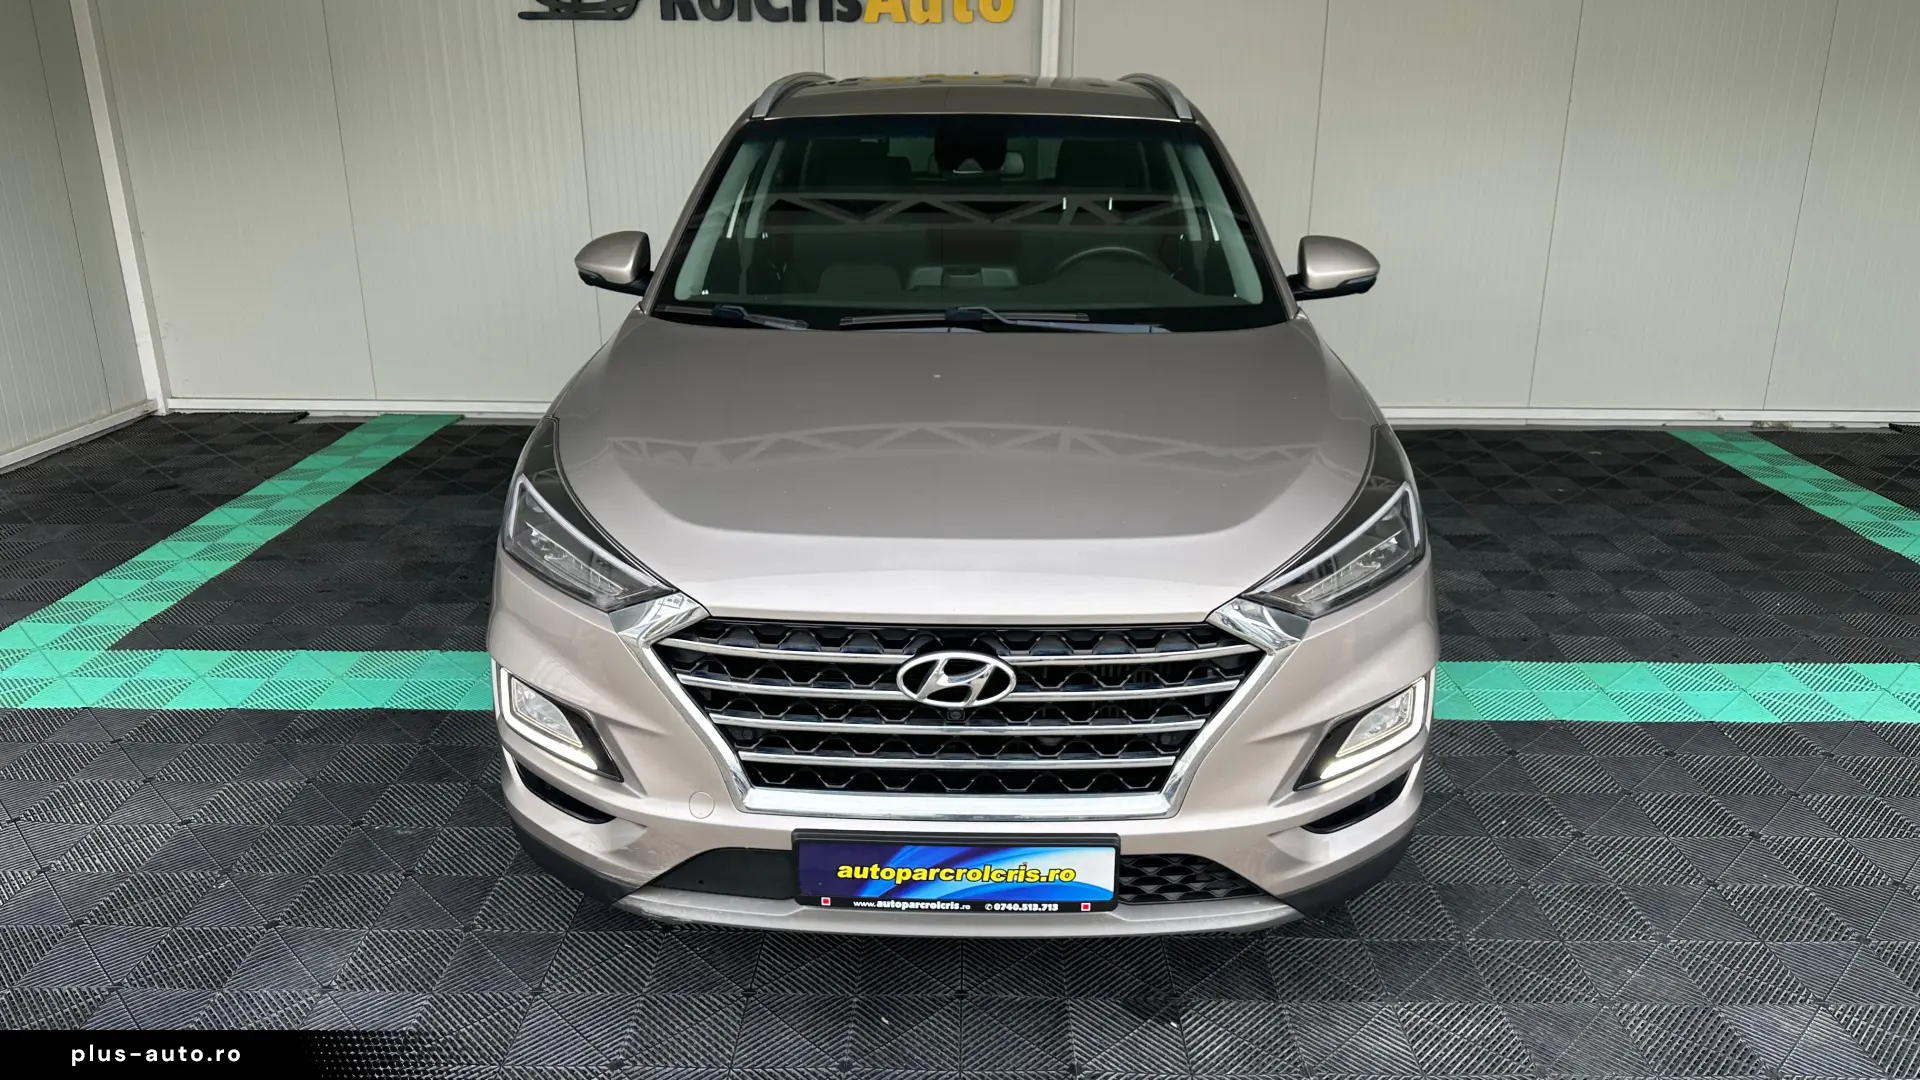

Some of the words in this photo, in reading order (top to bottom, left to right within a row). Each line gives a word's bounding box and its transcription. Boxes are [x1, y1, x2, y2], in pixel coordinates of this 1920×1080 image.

[837, 863, 1076, 884] autoparcrolcris.ro
[853, 900, 971, 910] www.autoparcrolcris.ro
[993, 903, 1059, 912] 0740.513.713
